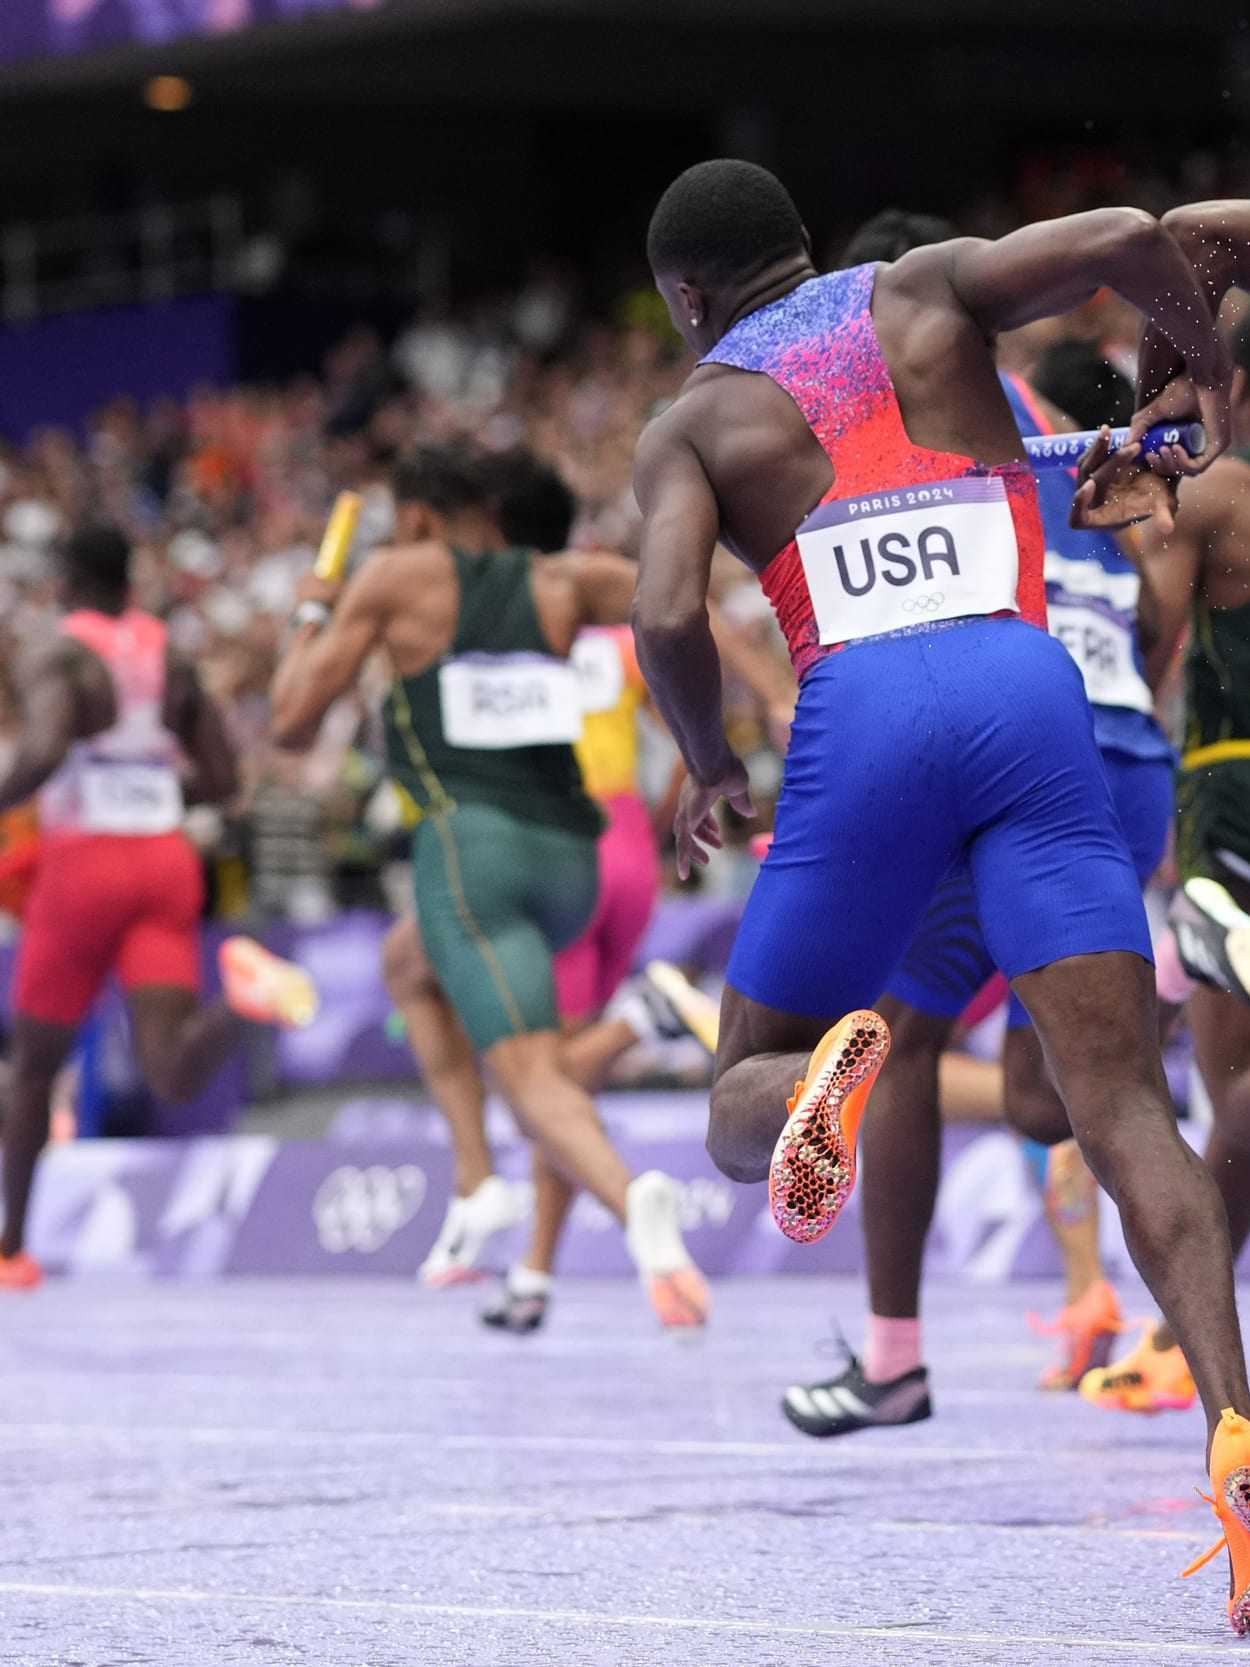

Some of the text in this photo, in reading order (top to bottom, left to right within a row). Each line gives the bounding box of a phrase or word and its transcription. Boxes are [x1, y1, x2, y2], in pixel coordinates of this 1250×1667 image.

[1030, 438, 1080, 459] 2024
[848, 487, 955, 516] PARIS 2024
[832, 525, 961, 597] USA
